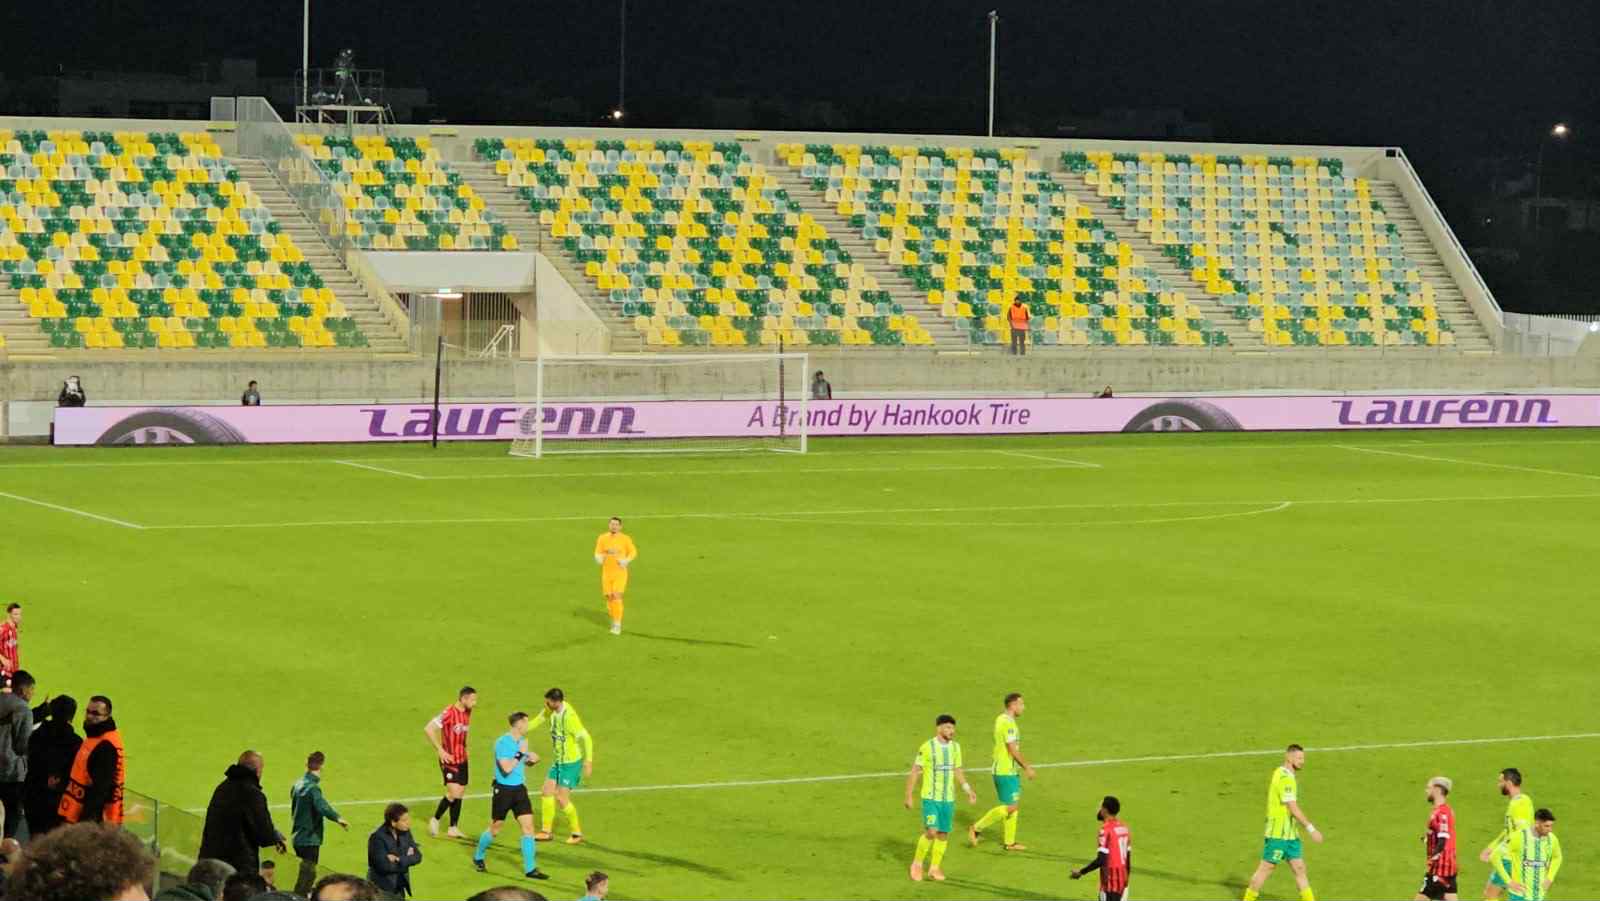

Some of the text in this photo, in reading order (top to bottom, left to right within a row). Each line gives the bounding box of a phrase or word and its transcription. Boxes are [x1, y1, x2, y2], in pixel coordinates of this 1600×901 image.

[747, 405, 764, 427] A
[848, 403, 877, 432] by
[882, 403, 982, 426] Hankook
[989, 403, 1031, 425] Tire
